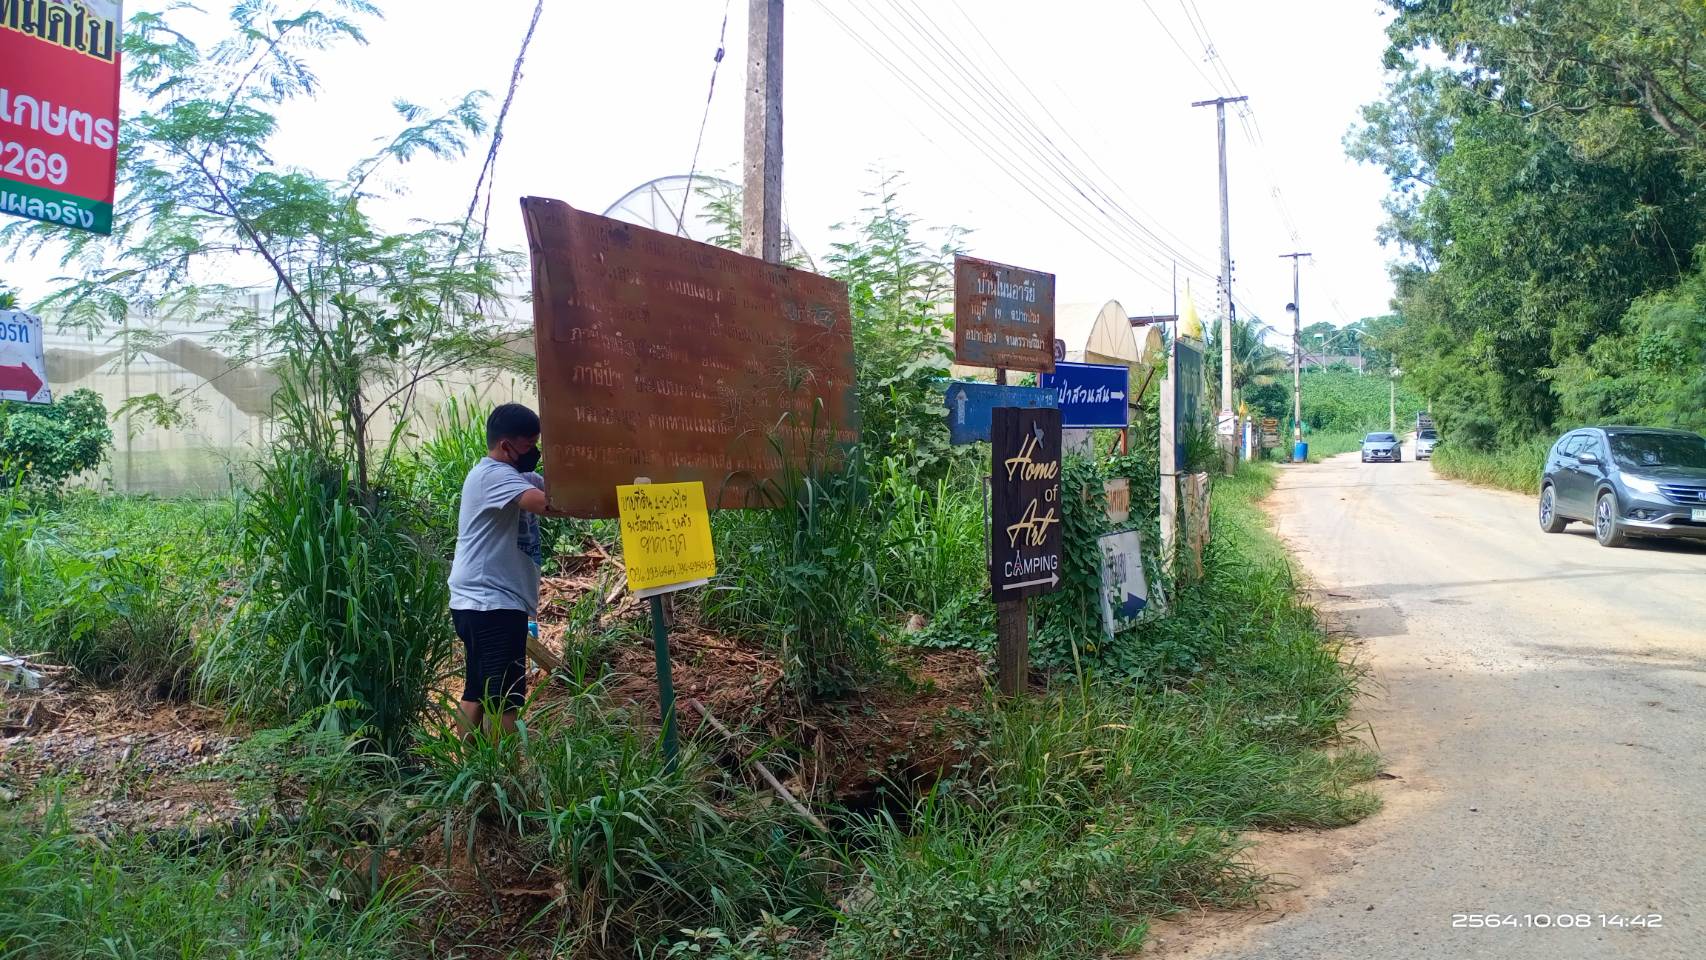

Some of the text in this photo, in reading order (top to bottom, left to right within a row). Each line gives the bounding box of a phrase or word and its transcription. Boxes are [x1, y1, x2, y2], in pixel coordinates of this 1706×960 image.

[0, 88, 114, 150] เกษตร
[0, 140, 68, 185] 269
[993, 307, 1002, 320] 19
[1005, 433, 1059, 482] Home
[1044, 483, 1058, 503] of
[1006, 498, 1059, 548] Art
[1004, 549, 1058, 578] CAMPING
